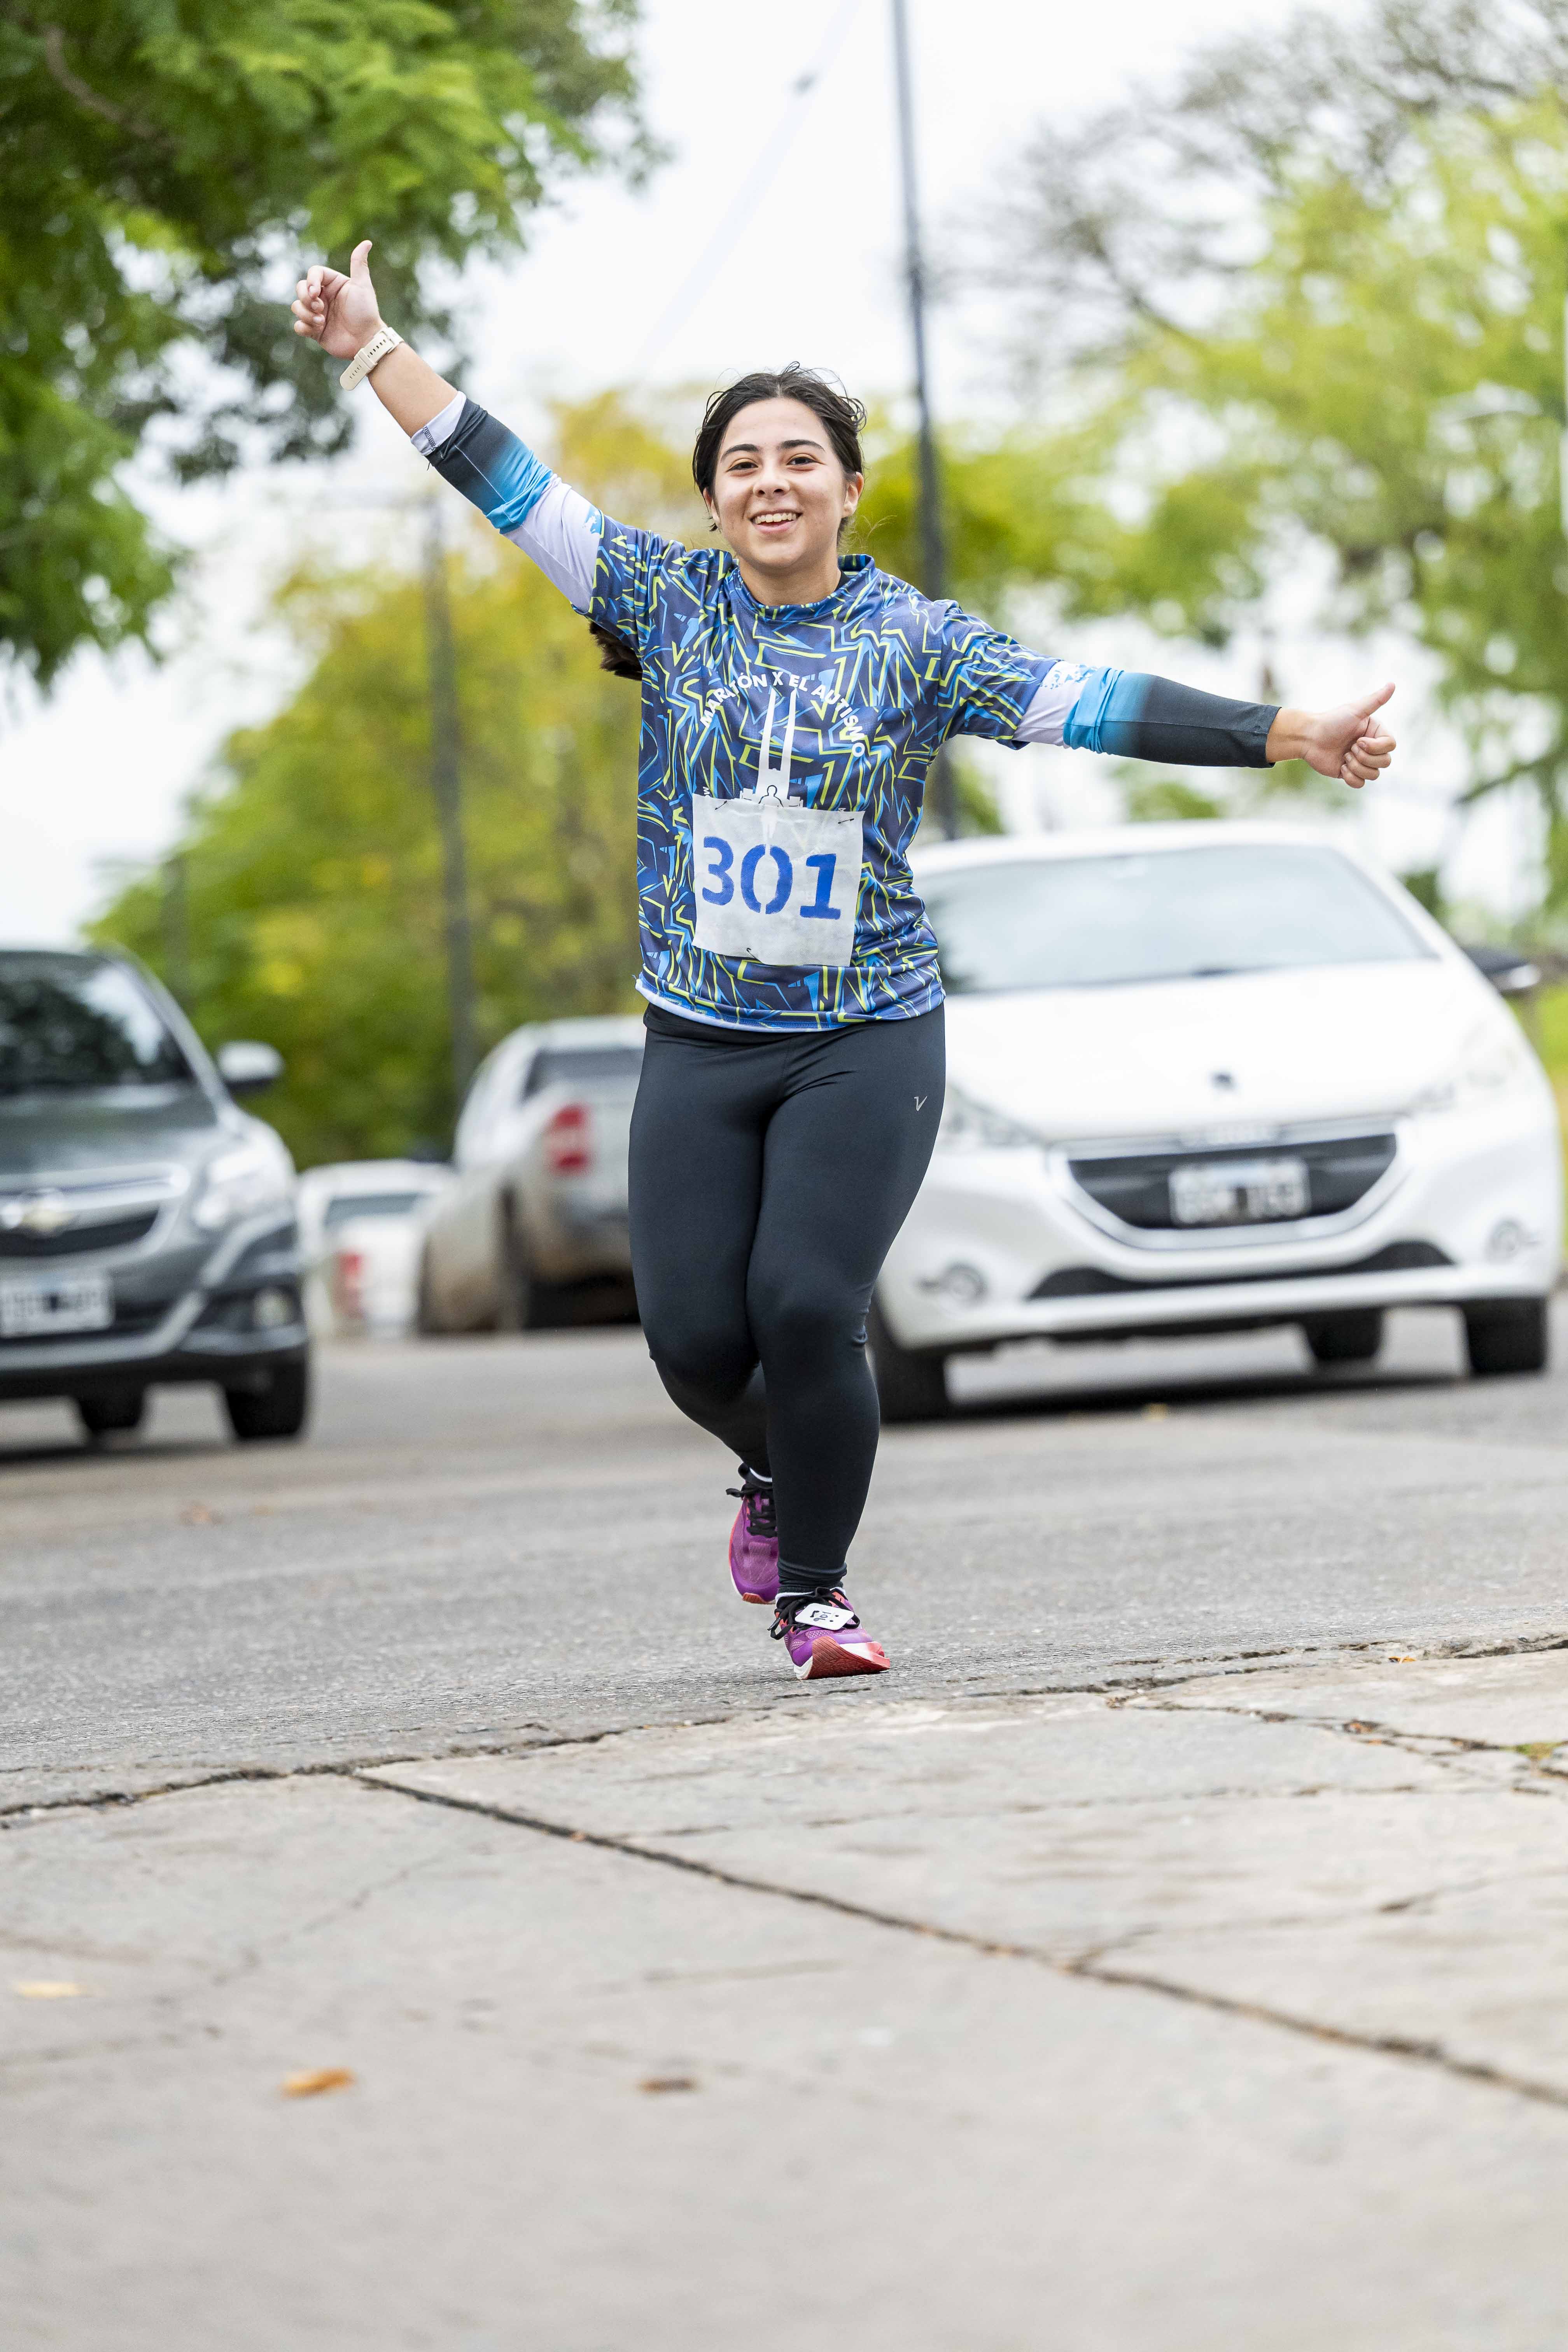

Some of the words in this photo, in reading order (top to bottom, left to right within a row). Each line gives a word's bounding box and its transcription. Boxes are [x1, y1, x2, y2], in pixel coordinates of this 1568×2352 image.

[700, 672, 767, 728] MARATÓN
[772, 671, 784, 686] X
[788, 675, 808, 691] EL
[811, 686, 865, 757] AUTISMO
[702, 836, 841, 920] 301
